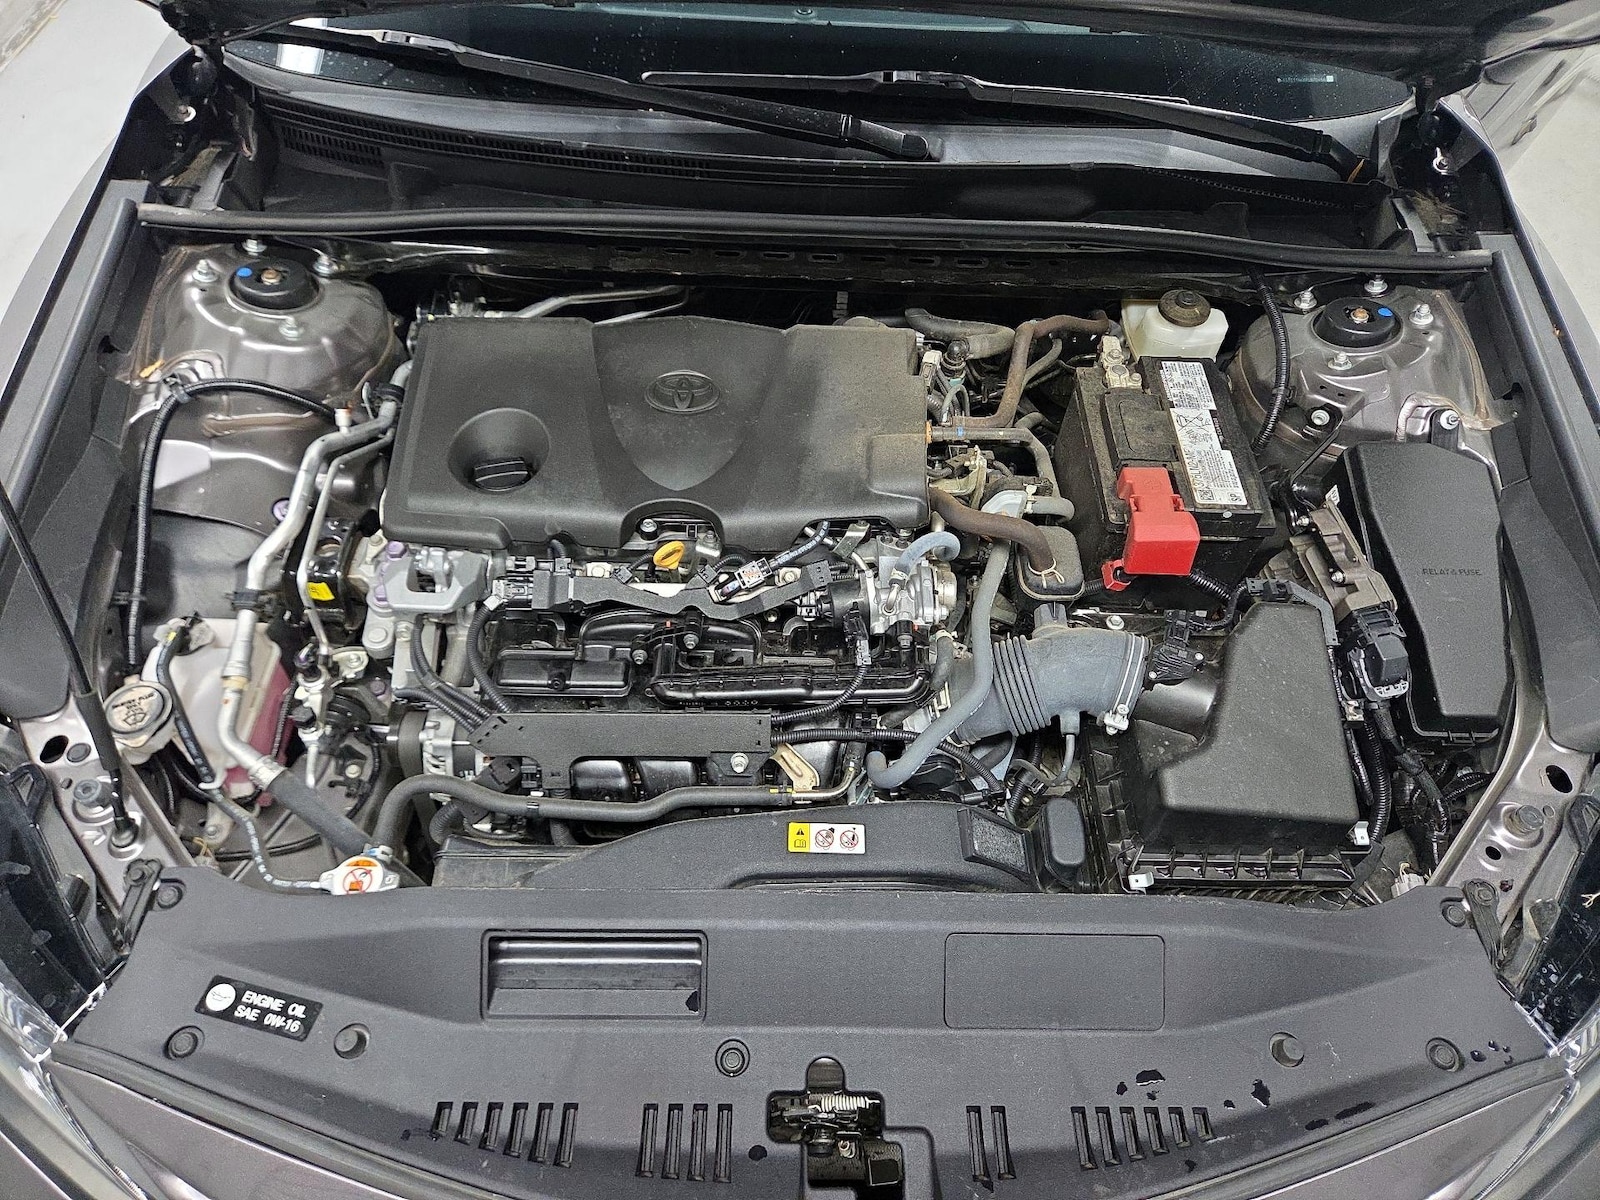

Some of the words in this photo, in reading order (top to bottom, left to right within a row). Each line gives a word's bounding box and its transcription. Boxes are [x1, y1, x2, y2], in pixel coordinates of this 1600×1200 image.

[1459, 568, 1482, 576] FUSE
[241, 991, 286, 1011] ENGINE
[288, 1003, 306, 1018] OIL
[234, 1005, 261, 1021] SAE
[264, 1013, 301, 1033] 0W-16
